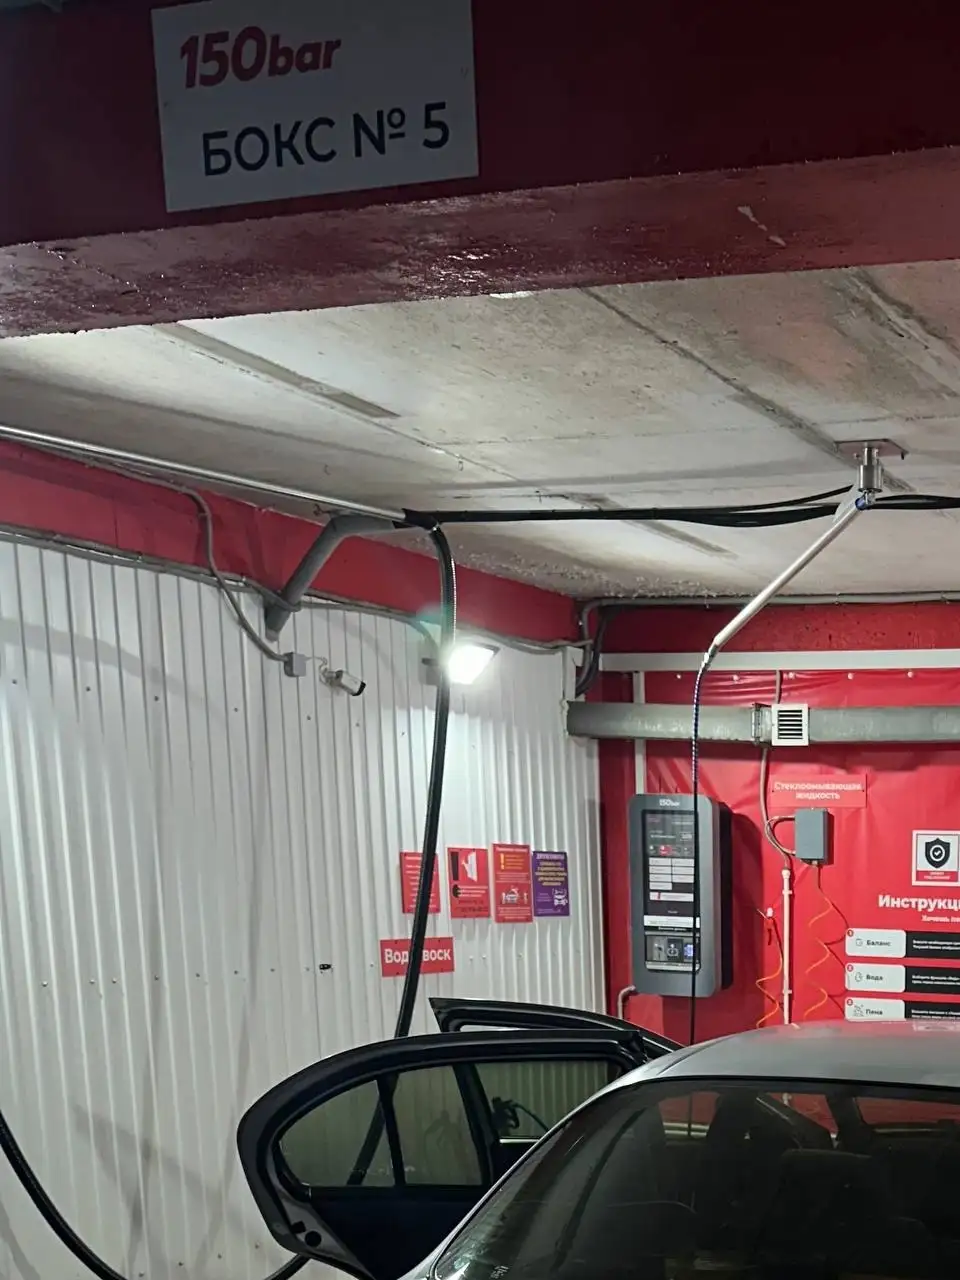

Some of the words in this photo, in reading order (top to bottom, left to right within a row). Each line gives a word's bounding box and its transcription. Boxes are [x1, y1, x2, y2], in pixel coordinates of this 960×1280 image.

[180, 26, 342, 89] 150bar
[203, 116, 337, 176] БОКС
[353, 108, 405, 157] №
[422, 102, 449, 149] 5
[384, 948, 412, 965] Вод
[422, 949, 452, 962] воск
